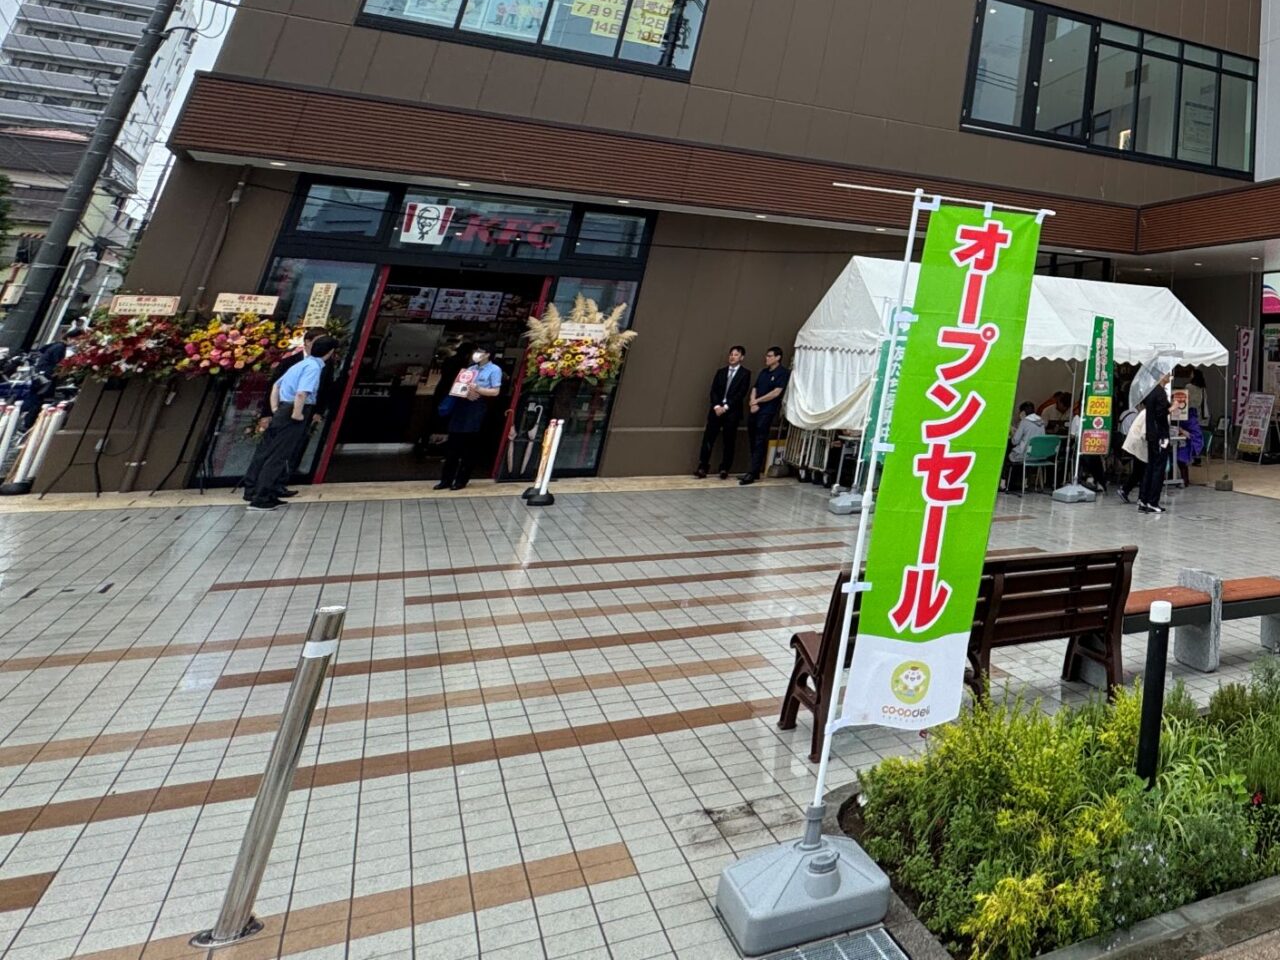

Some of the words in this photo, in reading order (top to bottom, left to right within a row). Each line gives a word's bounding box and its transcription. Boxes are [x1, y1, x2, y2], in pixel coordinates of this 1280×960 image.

[461, 214, 560, 249] KFC
[888, 219, 1012, 634] オープンセール
